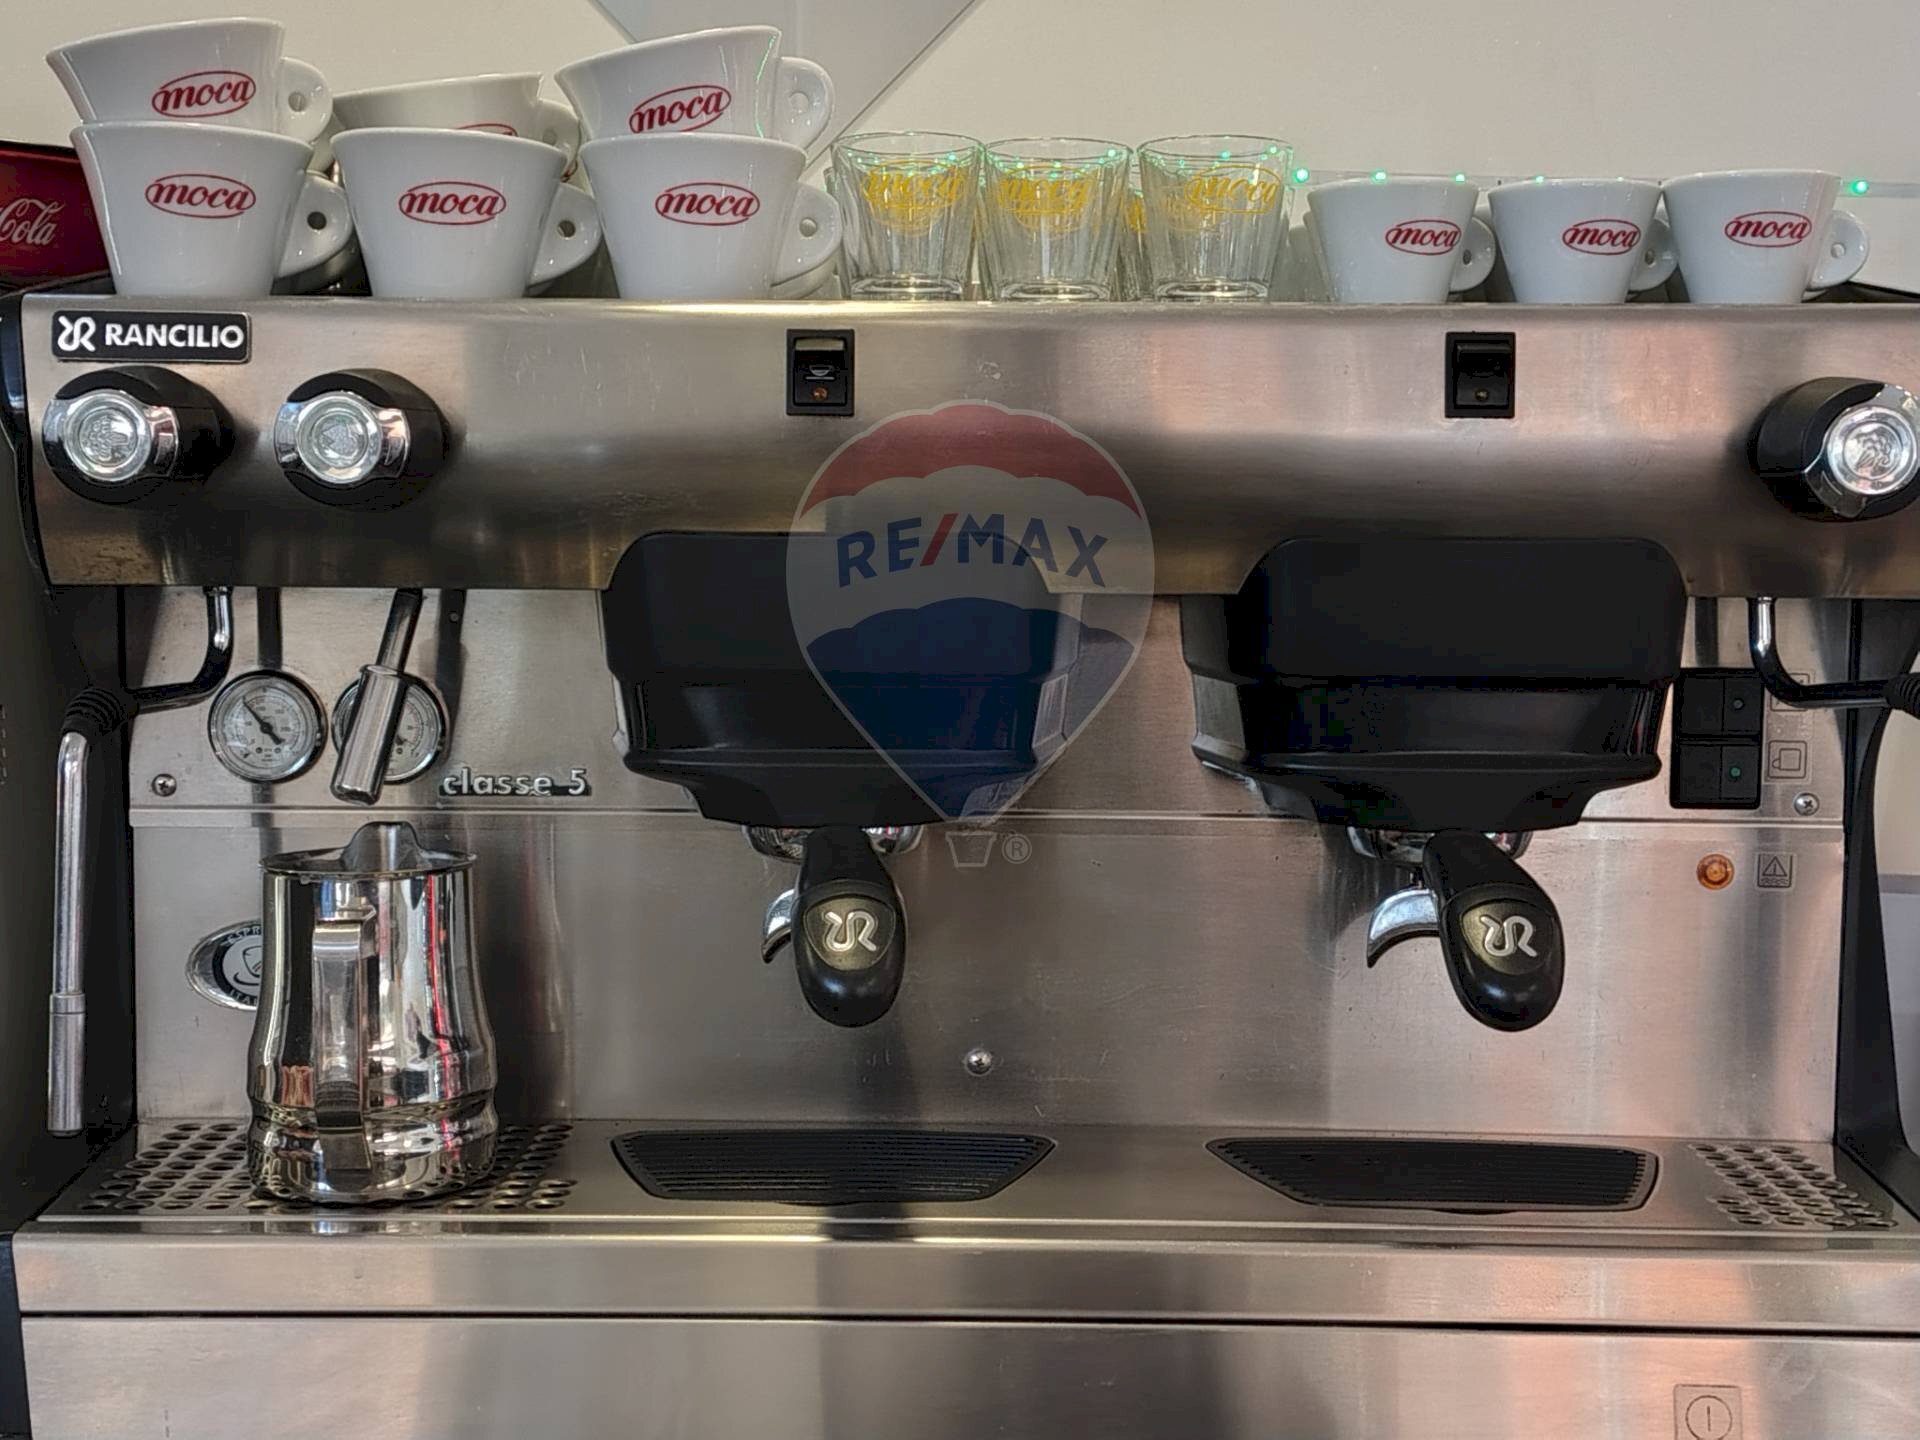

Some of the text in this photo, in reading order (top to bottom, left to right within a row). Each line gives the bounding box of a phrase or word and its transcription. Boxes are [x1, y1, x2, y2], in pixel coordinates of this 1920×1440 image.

[157, 80, 250, 111] moca
[633, 91, 723, 132] moca
[151, 182, 248, 211] moca
[403, 192, 500, 216] moca
[658, 192, 754, 218] moca
[1387, 227, 1460, 247] moca
[1567, 227, 1638, 247] moca
[1728, 219, 1808, 240] moca
[104, 323, 245, 349] RANCILIO
[442, 767, 587, 796] classe 5
